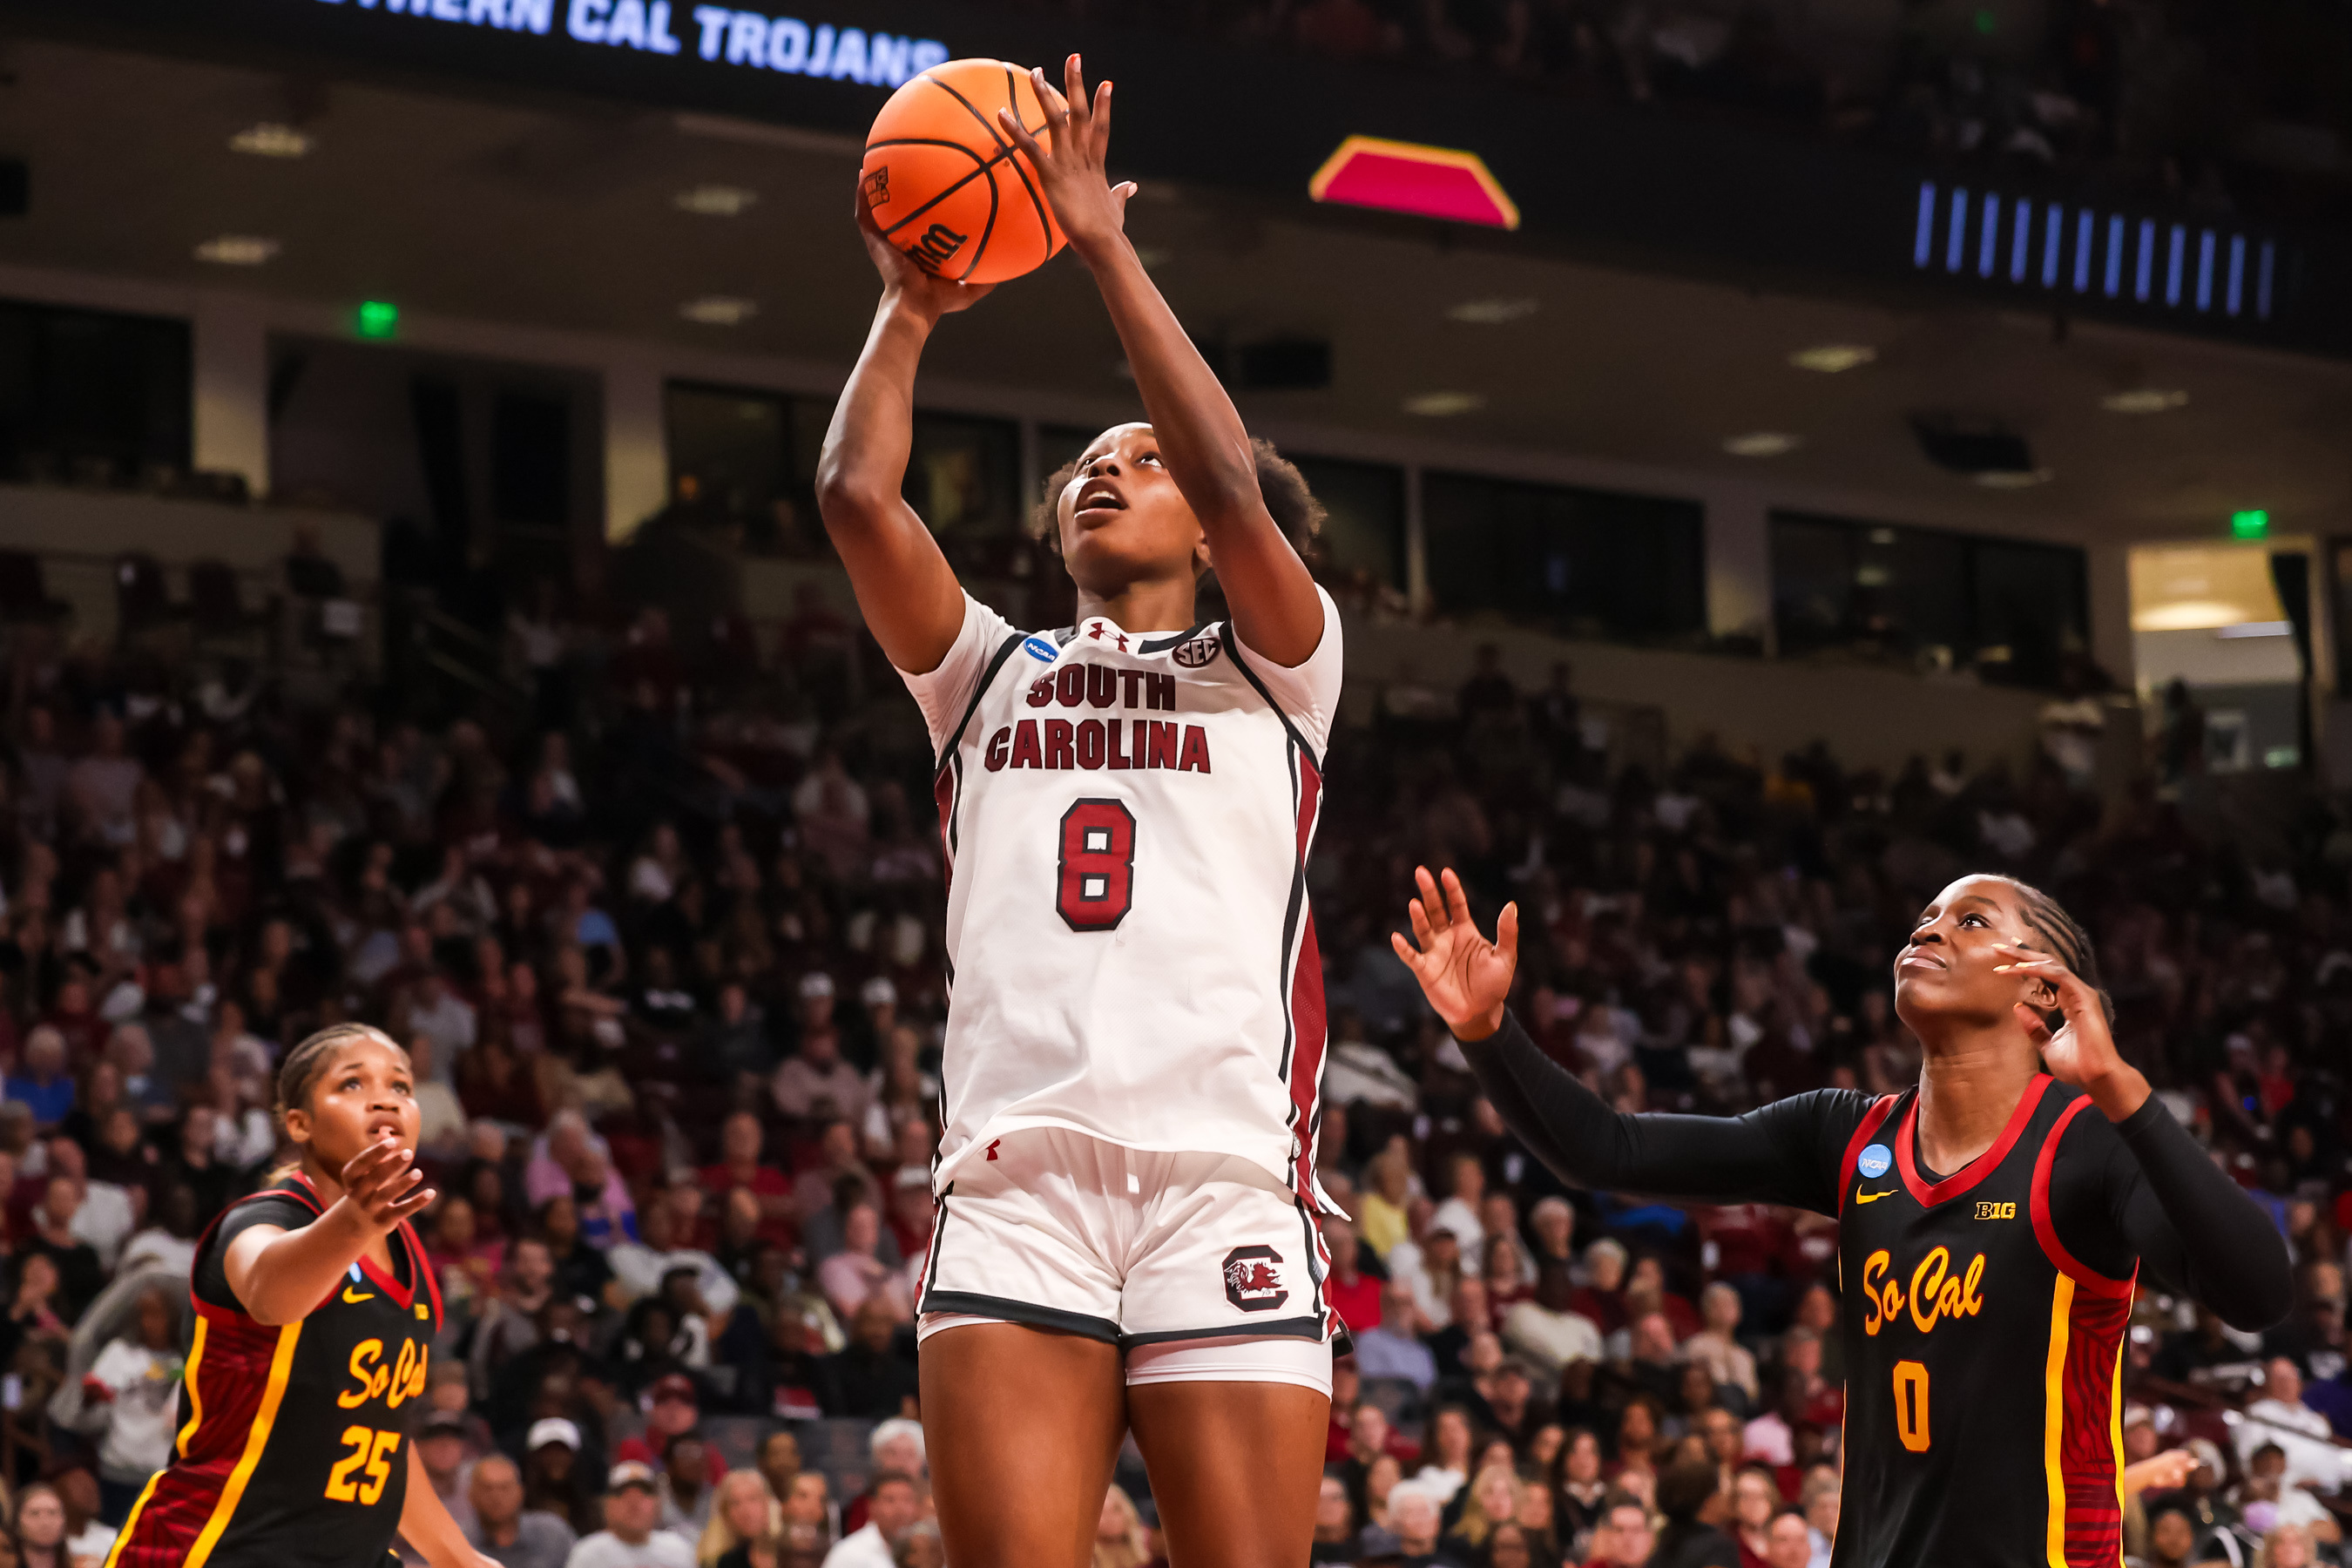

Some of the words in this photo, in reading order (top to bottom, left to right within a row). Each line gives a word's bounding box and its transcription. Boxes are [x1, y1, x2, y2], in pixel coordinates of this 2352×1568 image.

[565, 0, 682, 55] CAL
[1027, 642, 1056, 662] NCAA
[1176, 639, 1217, 666] SEC
[1026, 663, 1176, 712] SOUTH
[984, 719, 1211, 774] CAROLINA
[1056, 797, 1136, 932] 8
[1861, 1158, 1889, 1171] NCAA
[1863, 1248, 1905, 1336] So
[1909, 1245, 1987, 1334] Cal
[336, 1337, 390, 1409] So
[1893, 1359, 1930, 1454] 0
[324, 1424, 402, 1506] 25
